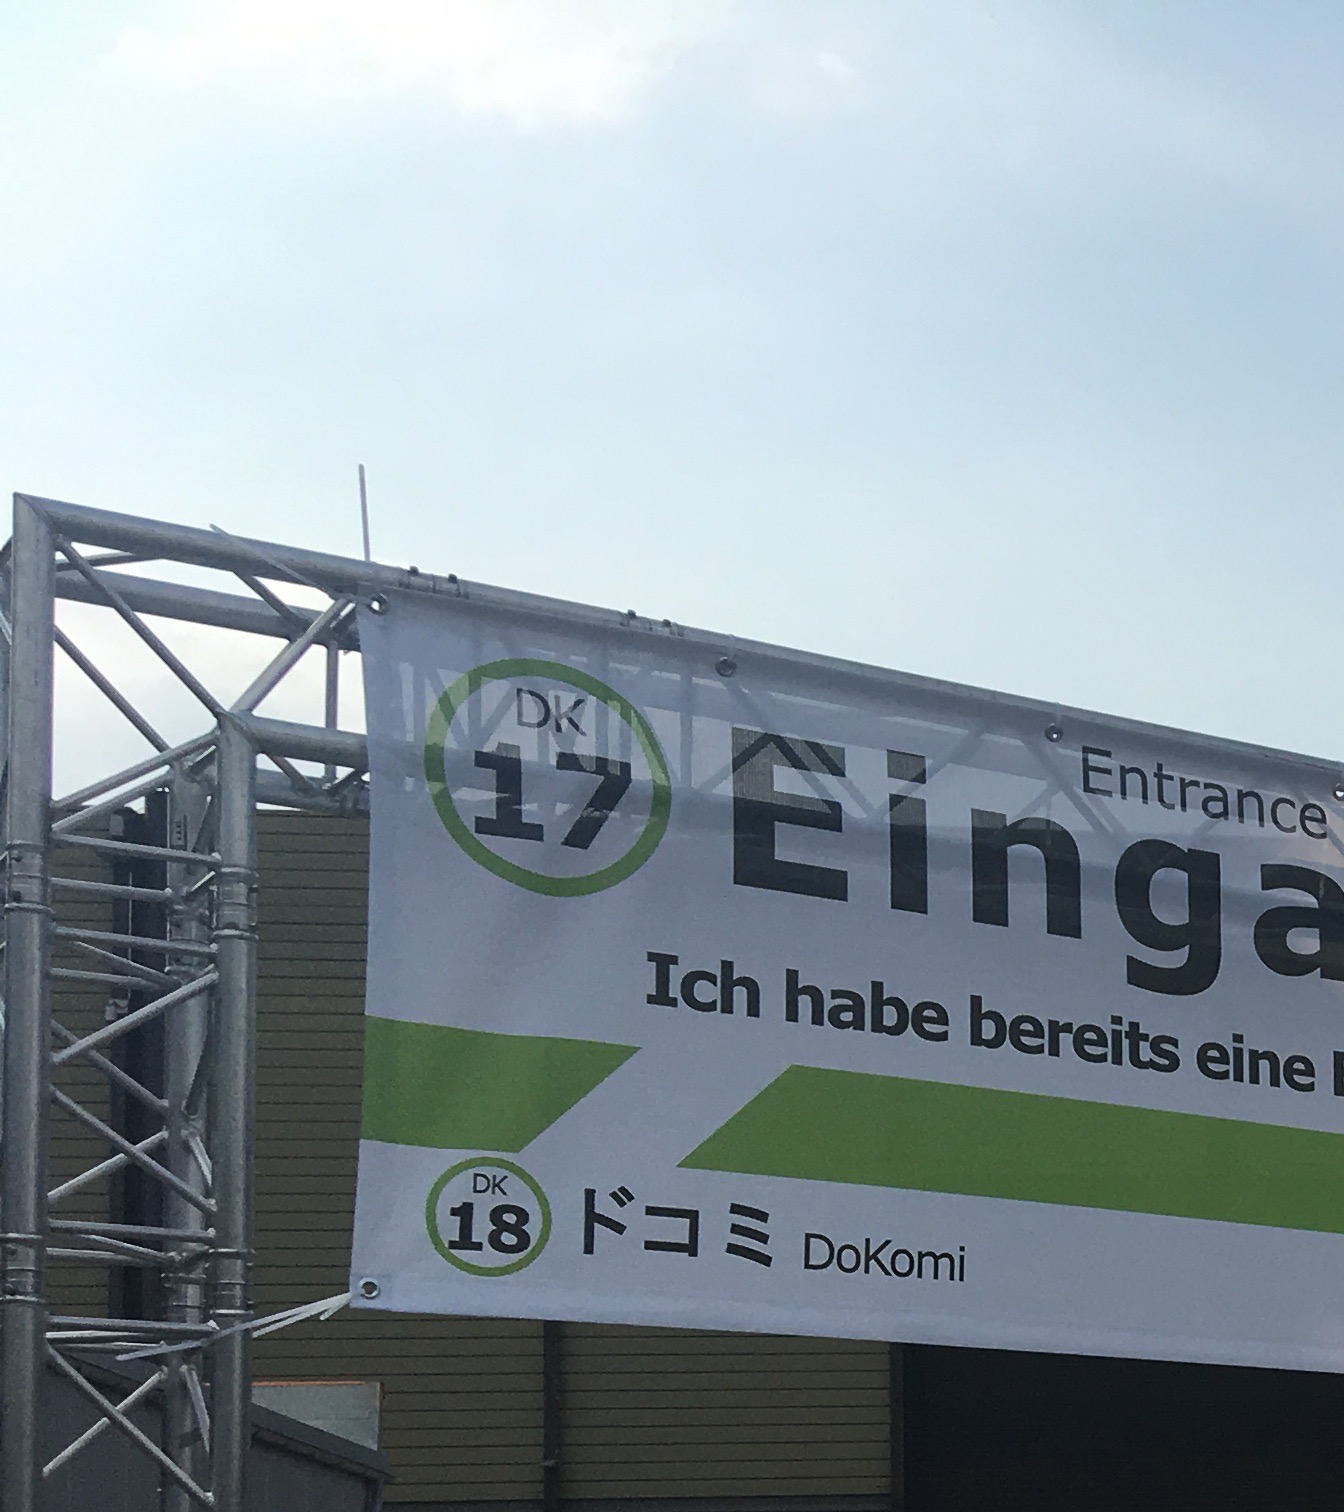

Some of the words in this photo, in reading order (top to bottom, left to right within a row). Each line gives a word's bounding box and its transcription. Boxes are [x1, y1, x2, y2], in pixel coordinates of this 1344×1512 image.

[516, 687, 586, 735] DK
[474, 741, 633, 850] 17
[1080, 746, 1329, 839] Entrance
[646, 951, 761, 1019] Ich
[784, 968, 950, 1043] habe
[970, 995, 1181, 1074] bereits
[1196, 1033, 1317, 1093] eine
[472, 1172, 510, 1197] DK
[447, 1201, 532, 1255] 18
[582, 1185, 774, 1268] ドコミ
[802, 1232, 967, 1284] DoKomi
